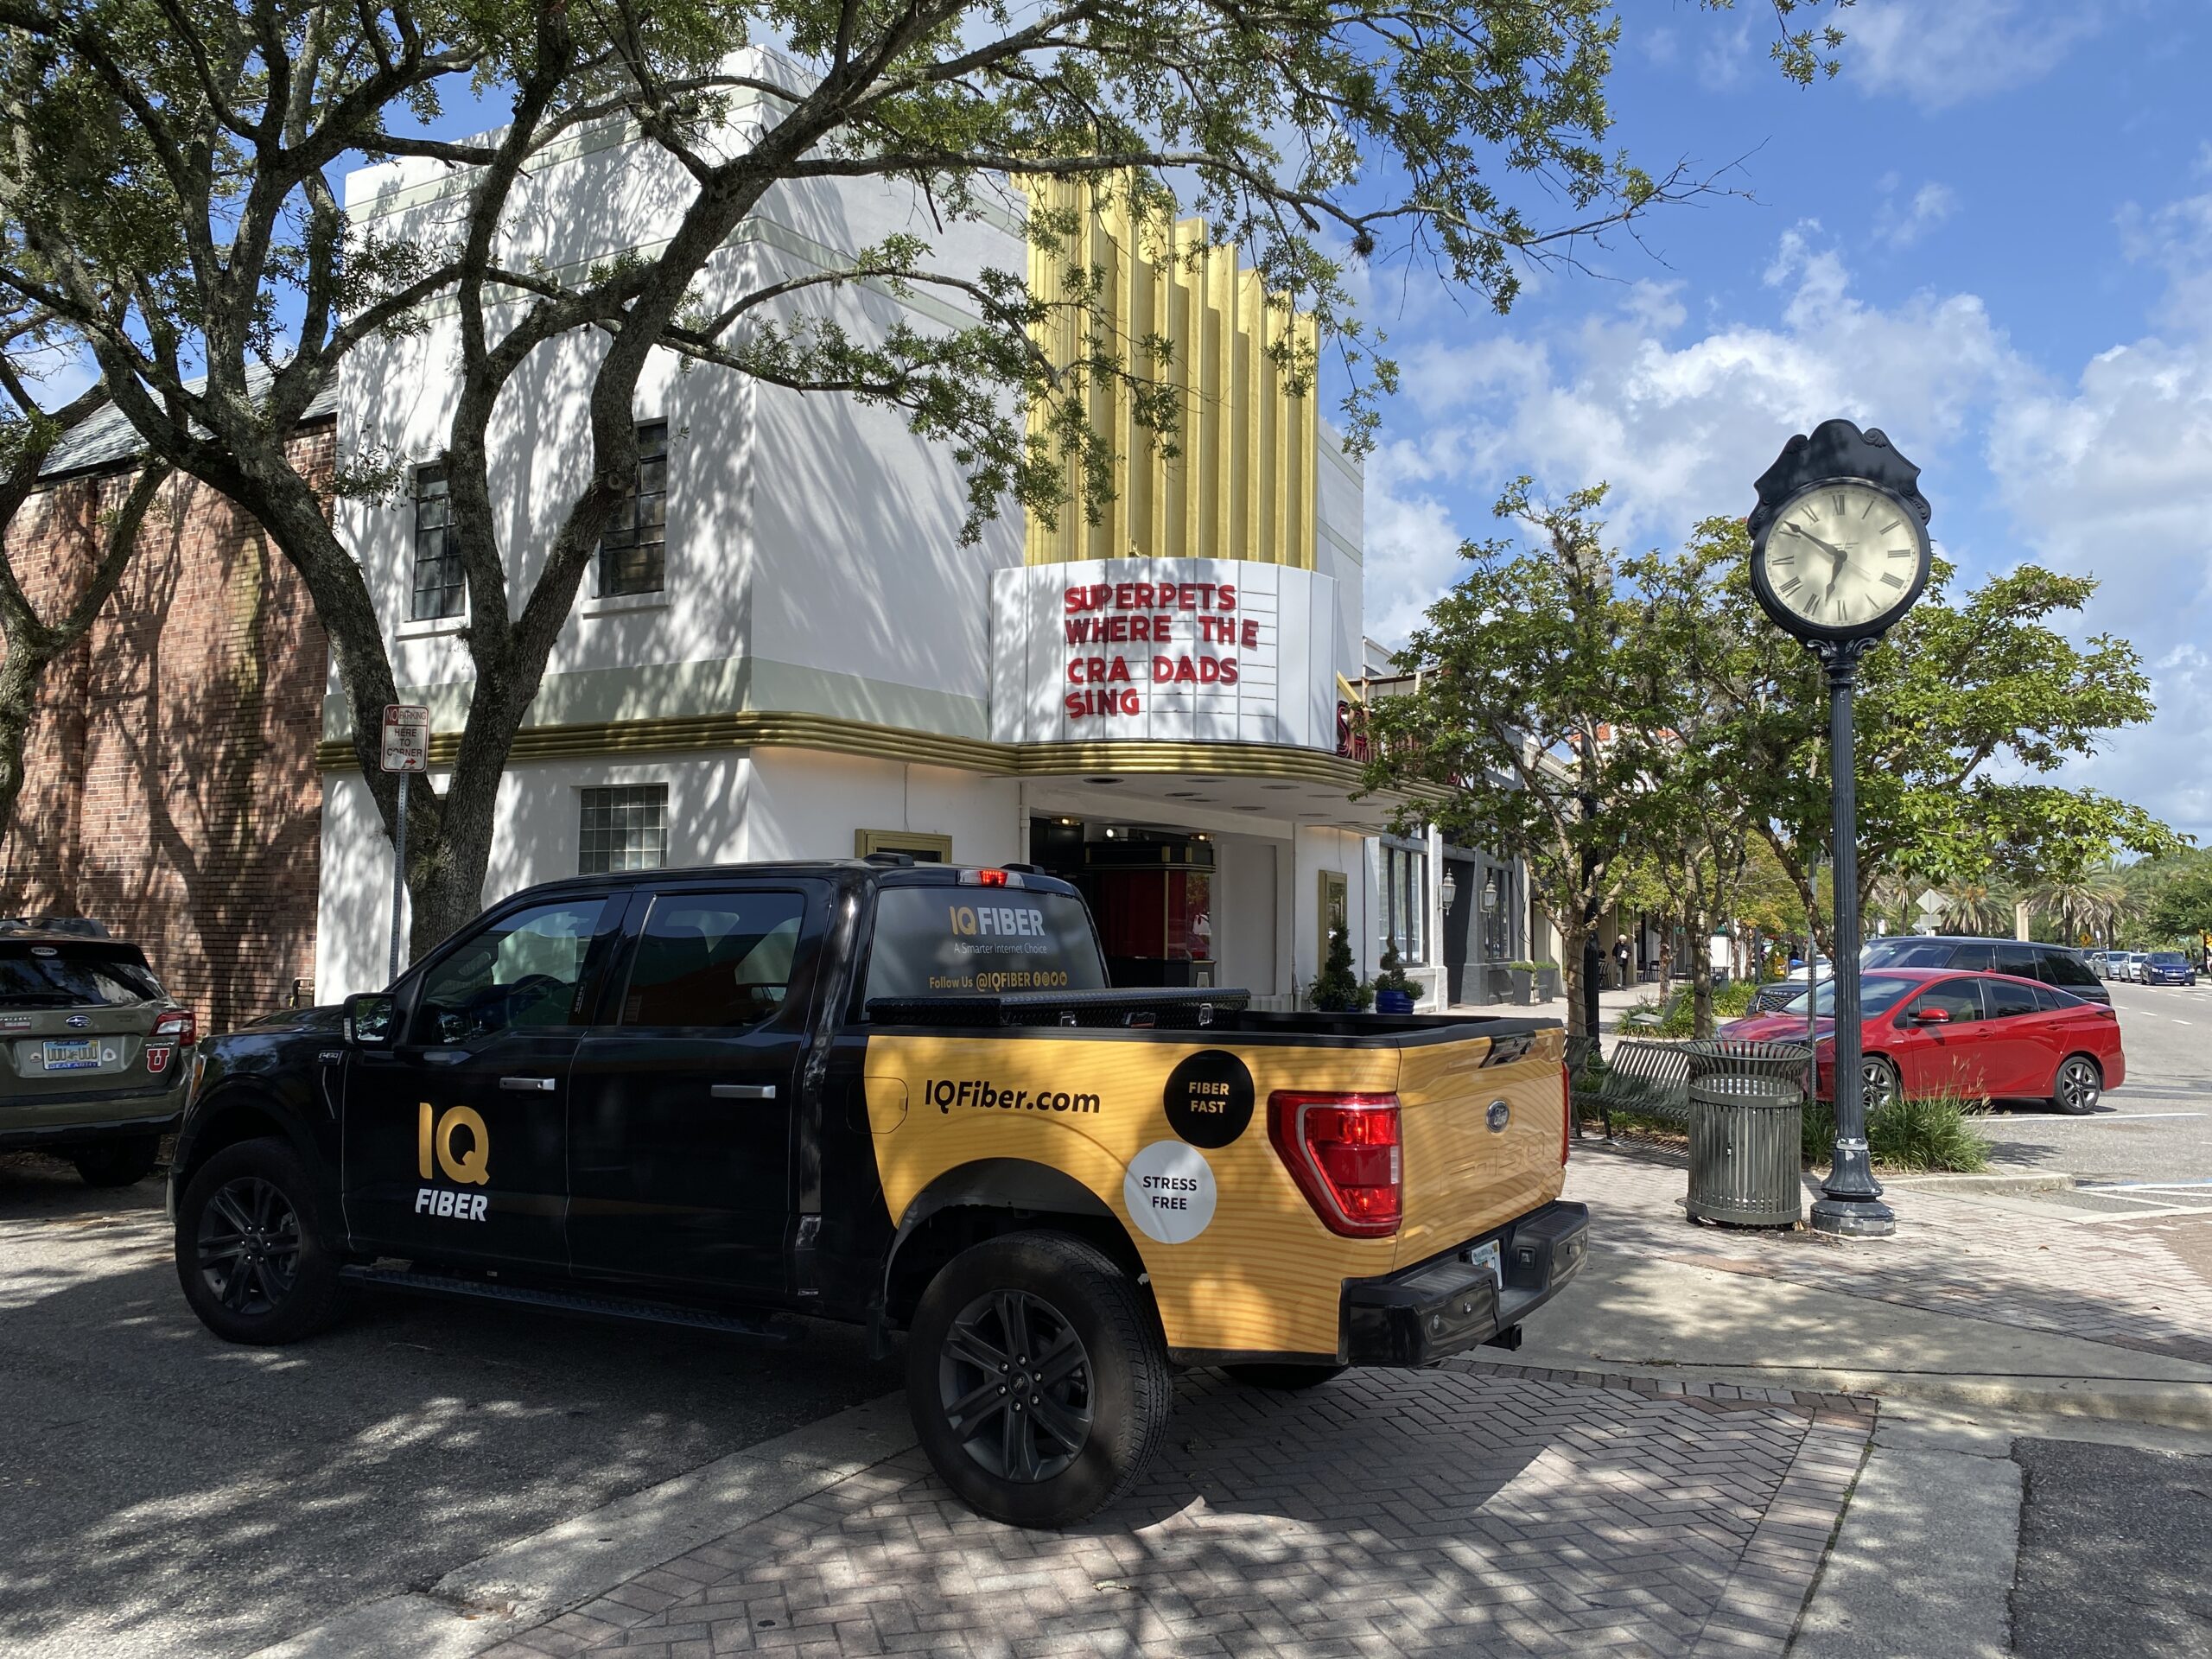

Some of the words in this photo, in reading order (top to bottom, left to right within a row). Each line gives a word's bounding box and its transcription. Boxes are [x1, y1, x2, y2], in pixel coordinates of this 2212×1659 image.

[1065, 615, 1172, 645] WHERE
[1198, 615, 1259, 650] THE
[1067, 656, 1131, 685] CRA
[1152, 655, 1238, 686] DADS
[1065, 688, 1140, 719] SING
[386, 709, 398, 721] NO
[399, 710, 426, 721] PARKING
[394, 728, 417, 737] HERE
[399, 738, 411, 747] TO
[953, 943, 960, 954] A
[961, 942, 994, 954] Smarter
[995, 943, 1023, 954] Internet
[1024, 943, 1047, 955] Choice
[929, 976, 959, 989] Follow
[961, 976, 973, 988] Us
[976, 971, 1031, 993] @IQFIBER
[147, 1048, 170, 1073] U
[925, 1079, 1100, 1114] IQFiber.com
[1188, 1081, 1230, 1096] FIBER
[1190, 1099, 1226, 1114] FAST
[418, 1102, 490, 1185] IQ
[1142, 1175, 1198, 1192] STRESS
[415, 1187, 488, 1223] FIBER
[1151, 1195, 1187, 1211] FREE
